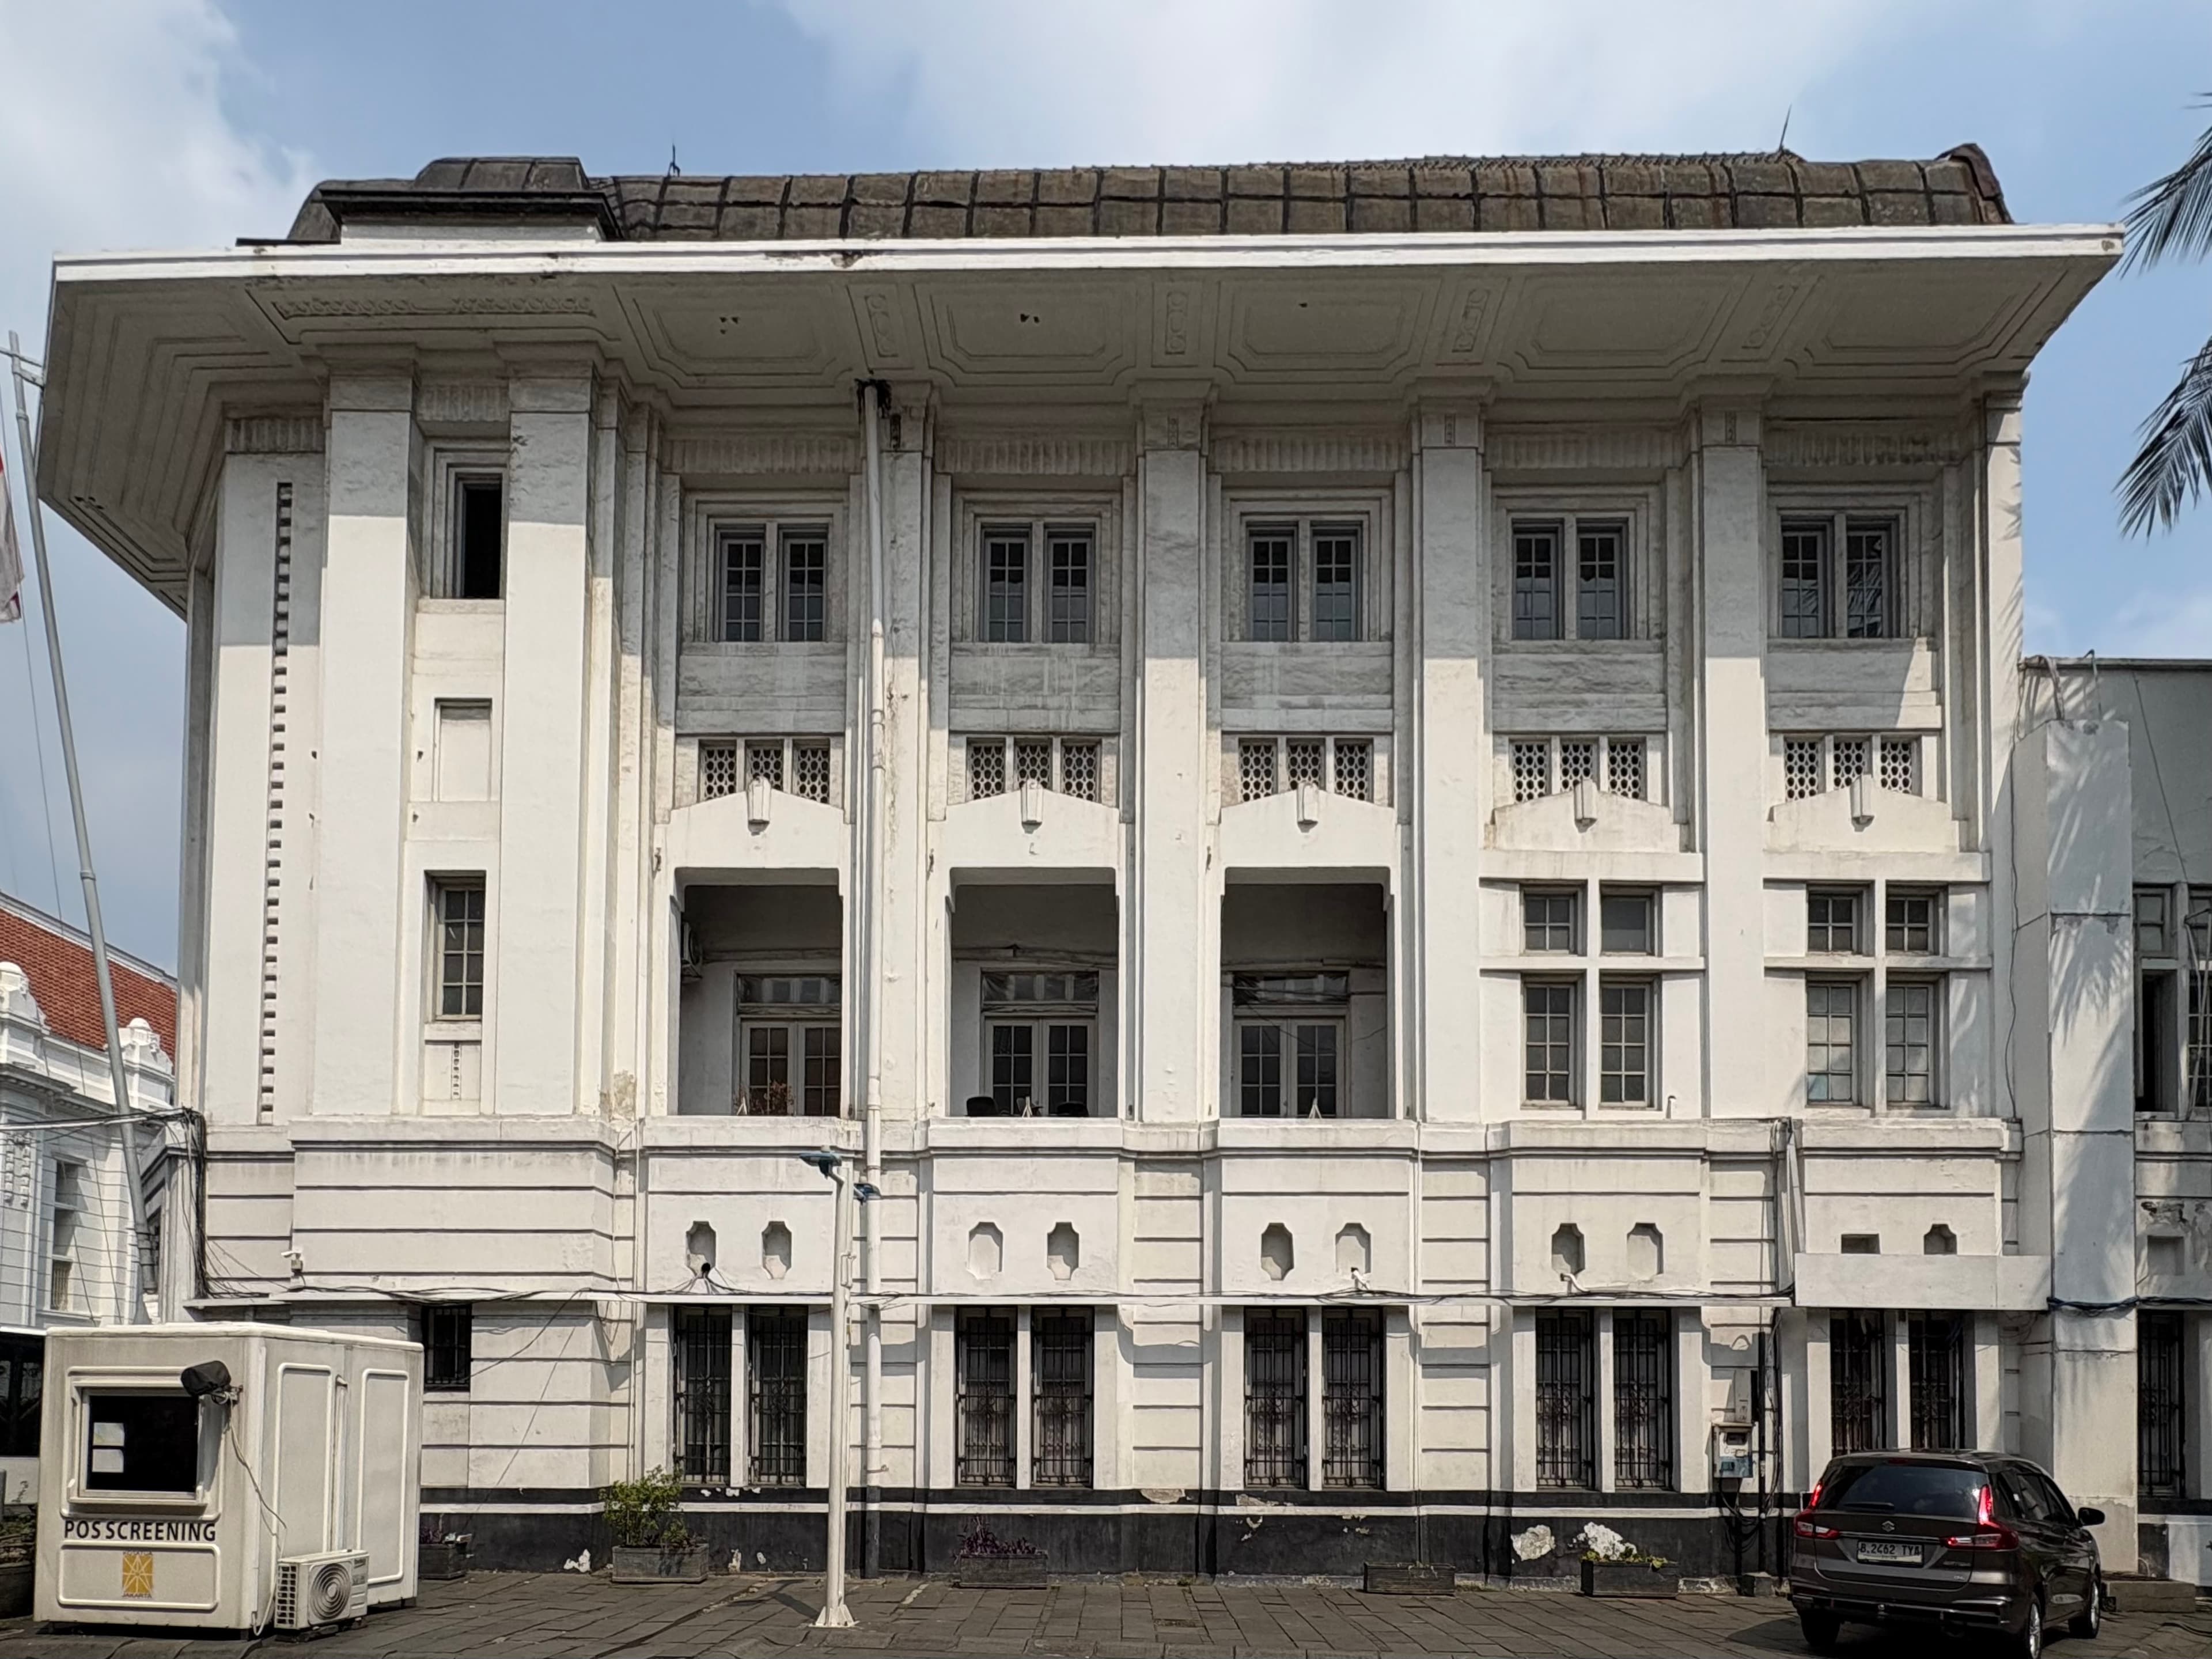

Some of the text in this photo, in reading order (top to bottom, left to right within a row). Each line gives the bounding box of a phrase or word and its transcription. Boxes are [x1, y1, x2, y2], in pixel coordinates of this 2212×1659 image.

[64, 1520, 216, 1541] POS SCREENING
[1902, 1545, 1921, 1556] TYA
